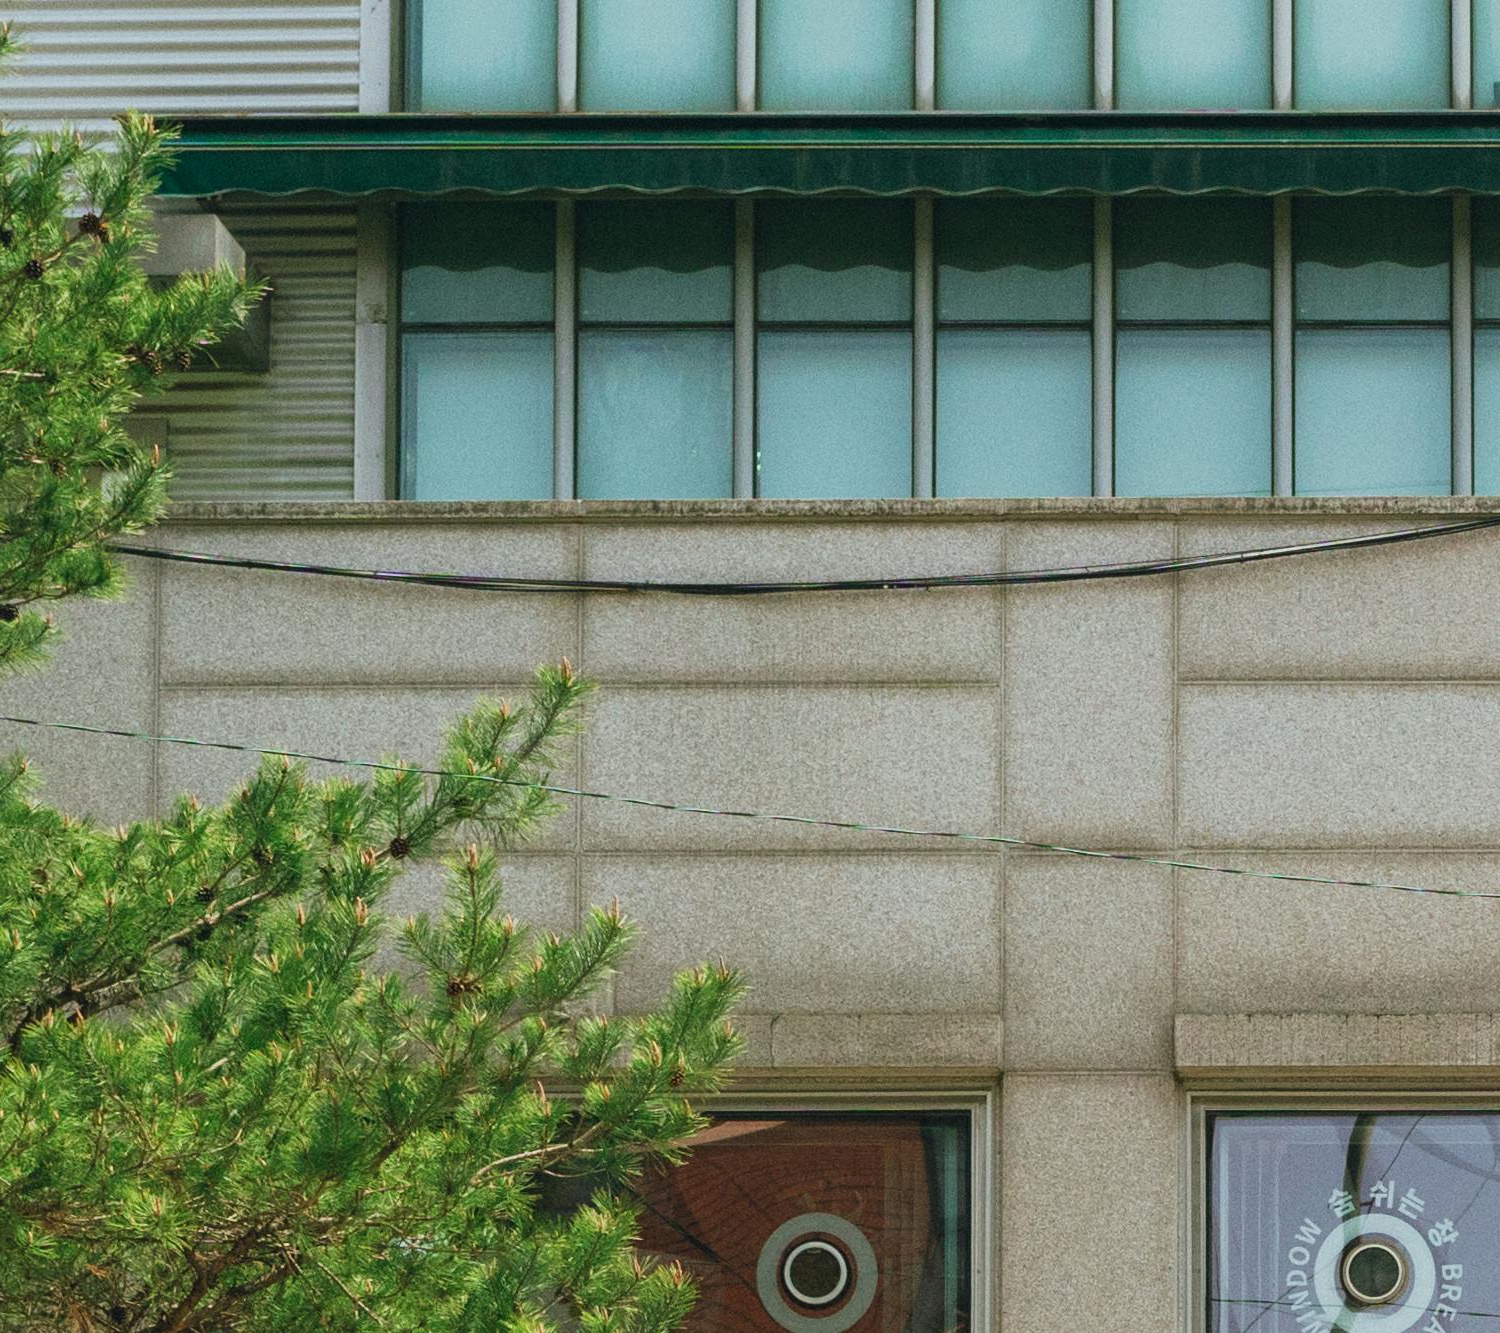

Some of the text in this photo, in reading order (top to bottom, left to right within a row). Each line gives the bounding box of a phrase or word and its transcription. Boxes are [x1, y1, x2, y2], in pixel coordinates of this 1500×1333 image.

[1327, 1179, 1462, 1248] 숨 쉬는 창
